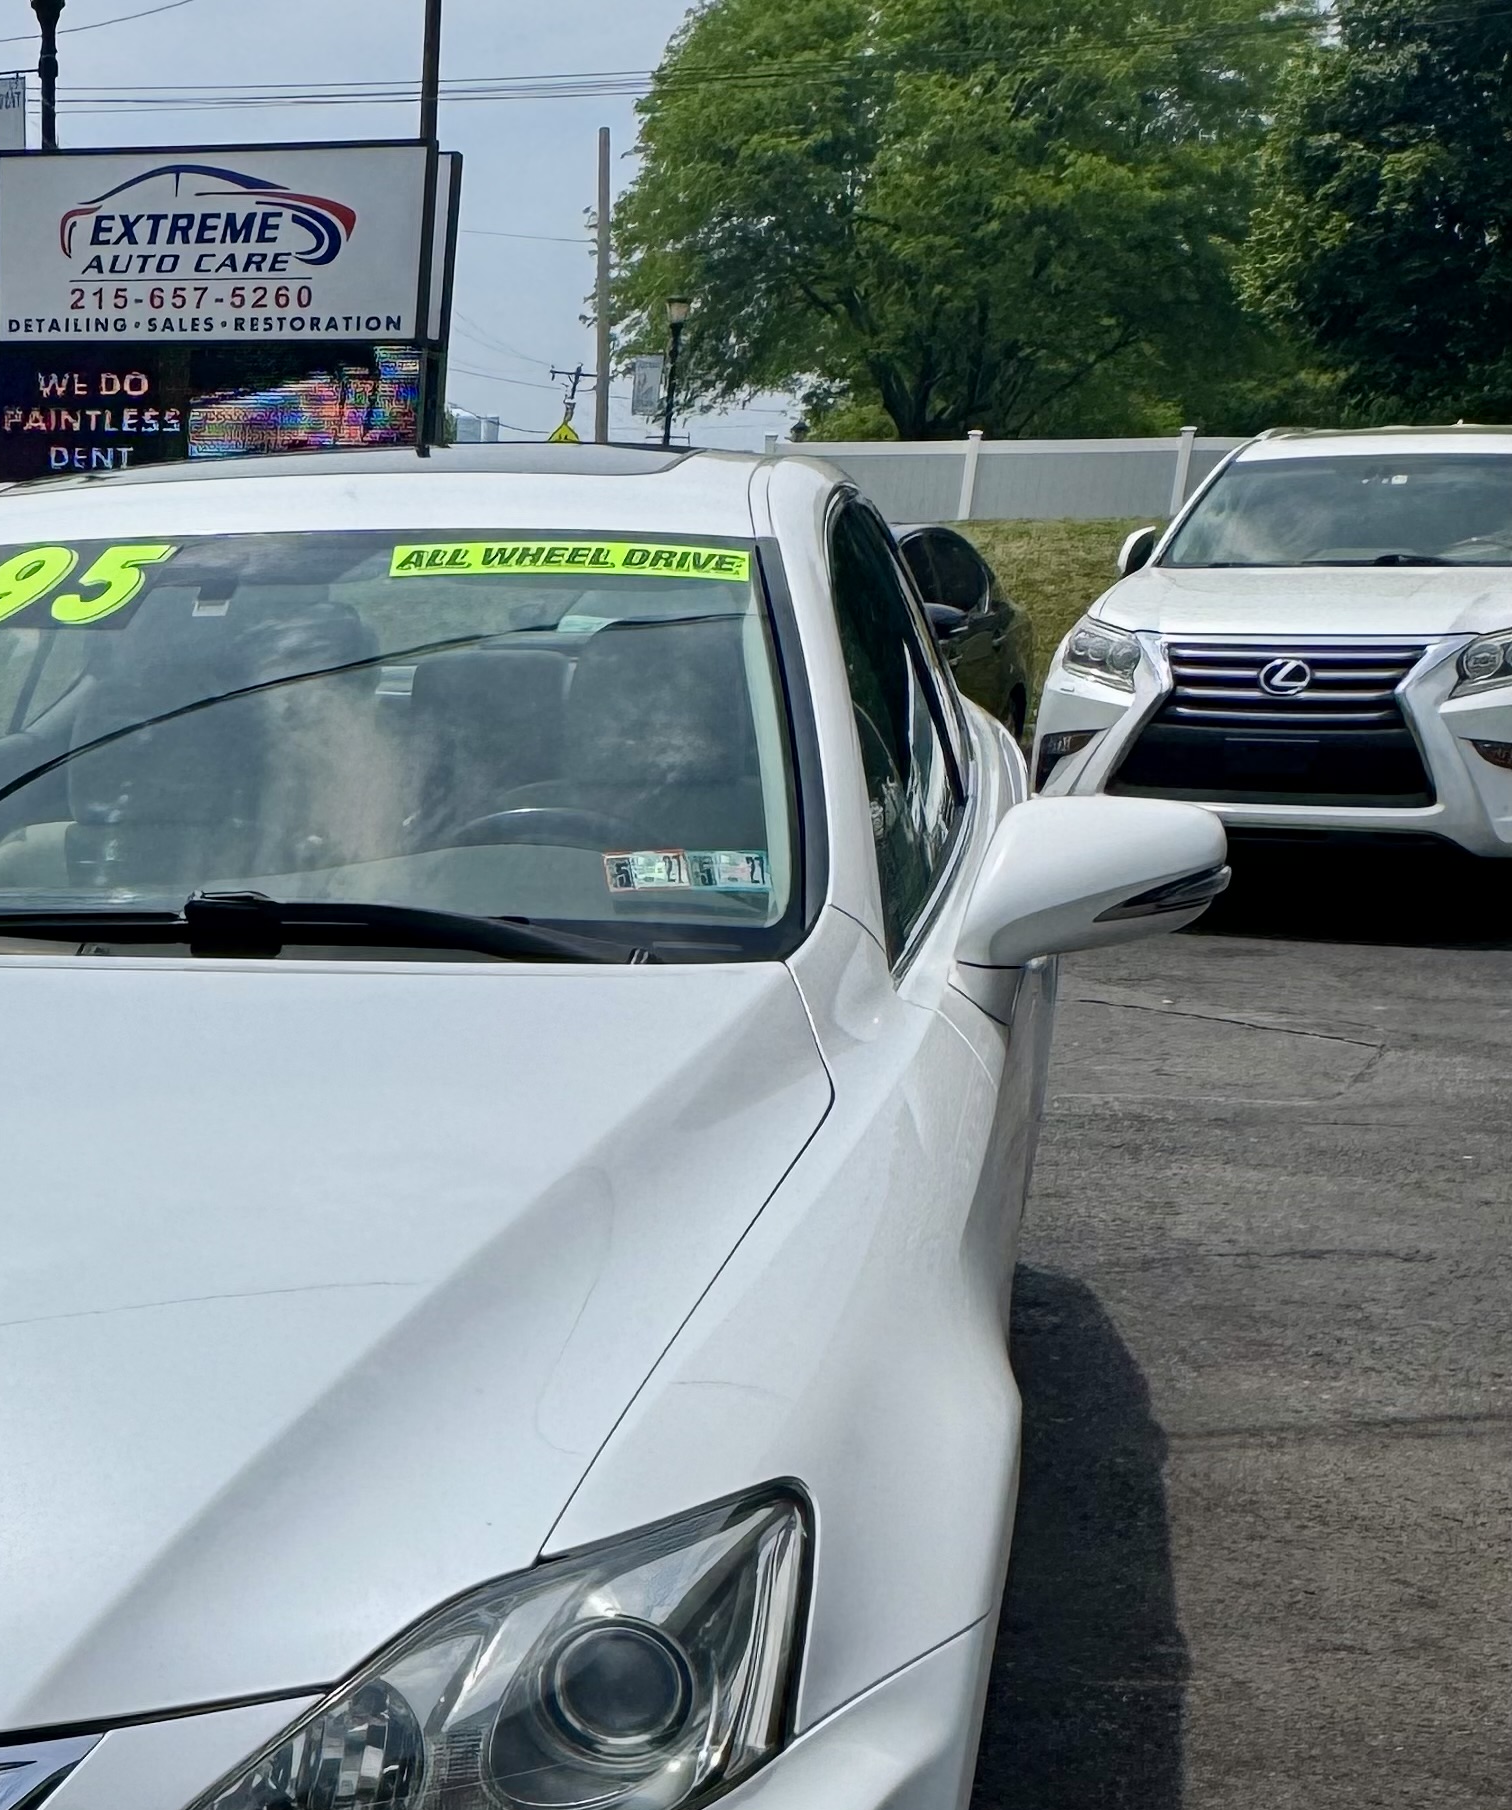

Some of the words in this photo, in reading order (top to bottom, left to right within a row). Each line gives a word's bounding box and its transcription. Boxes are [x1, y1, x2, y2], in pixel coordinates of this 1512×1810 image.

[90, 212, 283, 246] EXTREME
[81, 254, 180, 275] AUTO
[194, 252, 292, 273] CARE
[70, 285, 313, 310] 215-657-5260
[8, 317, 127, 333] DETAILING
[148, 317, 213, 333] SALES
[234, 315, 402, 333] RESTORATION
[38, 372, 88, 398] WE
[100, 371, 149, 396] DO
[3, 406, 181, 433] PAINTLESS
[50, 446, 134, 470] DENT
[396, 549, 472, 570] ALL
[480, 546, 615, 569] WHEEL
[621, 550, 746, 576] DRIVE
